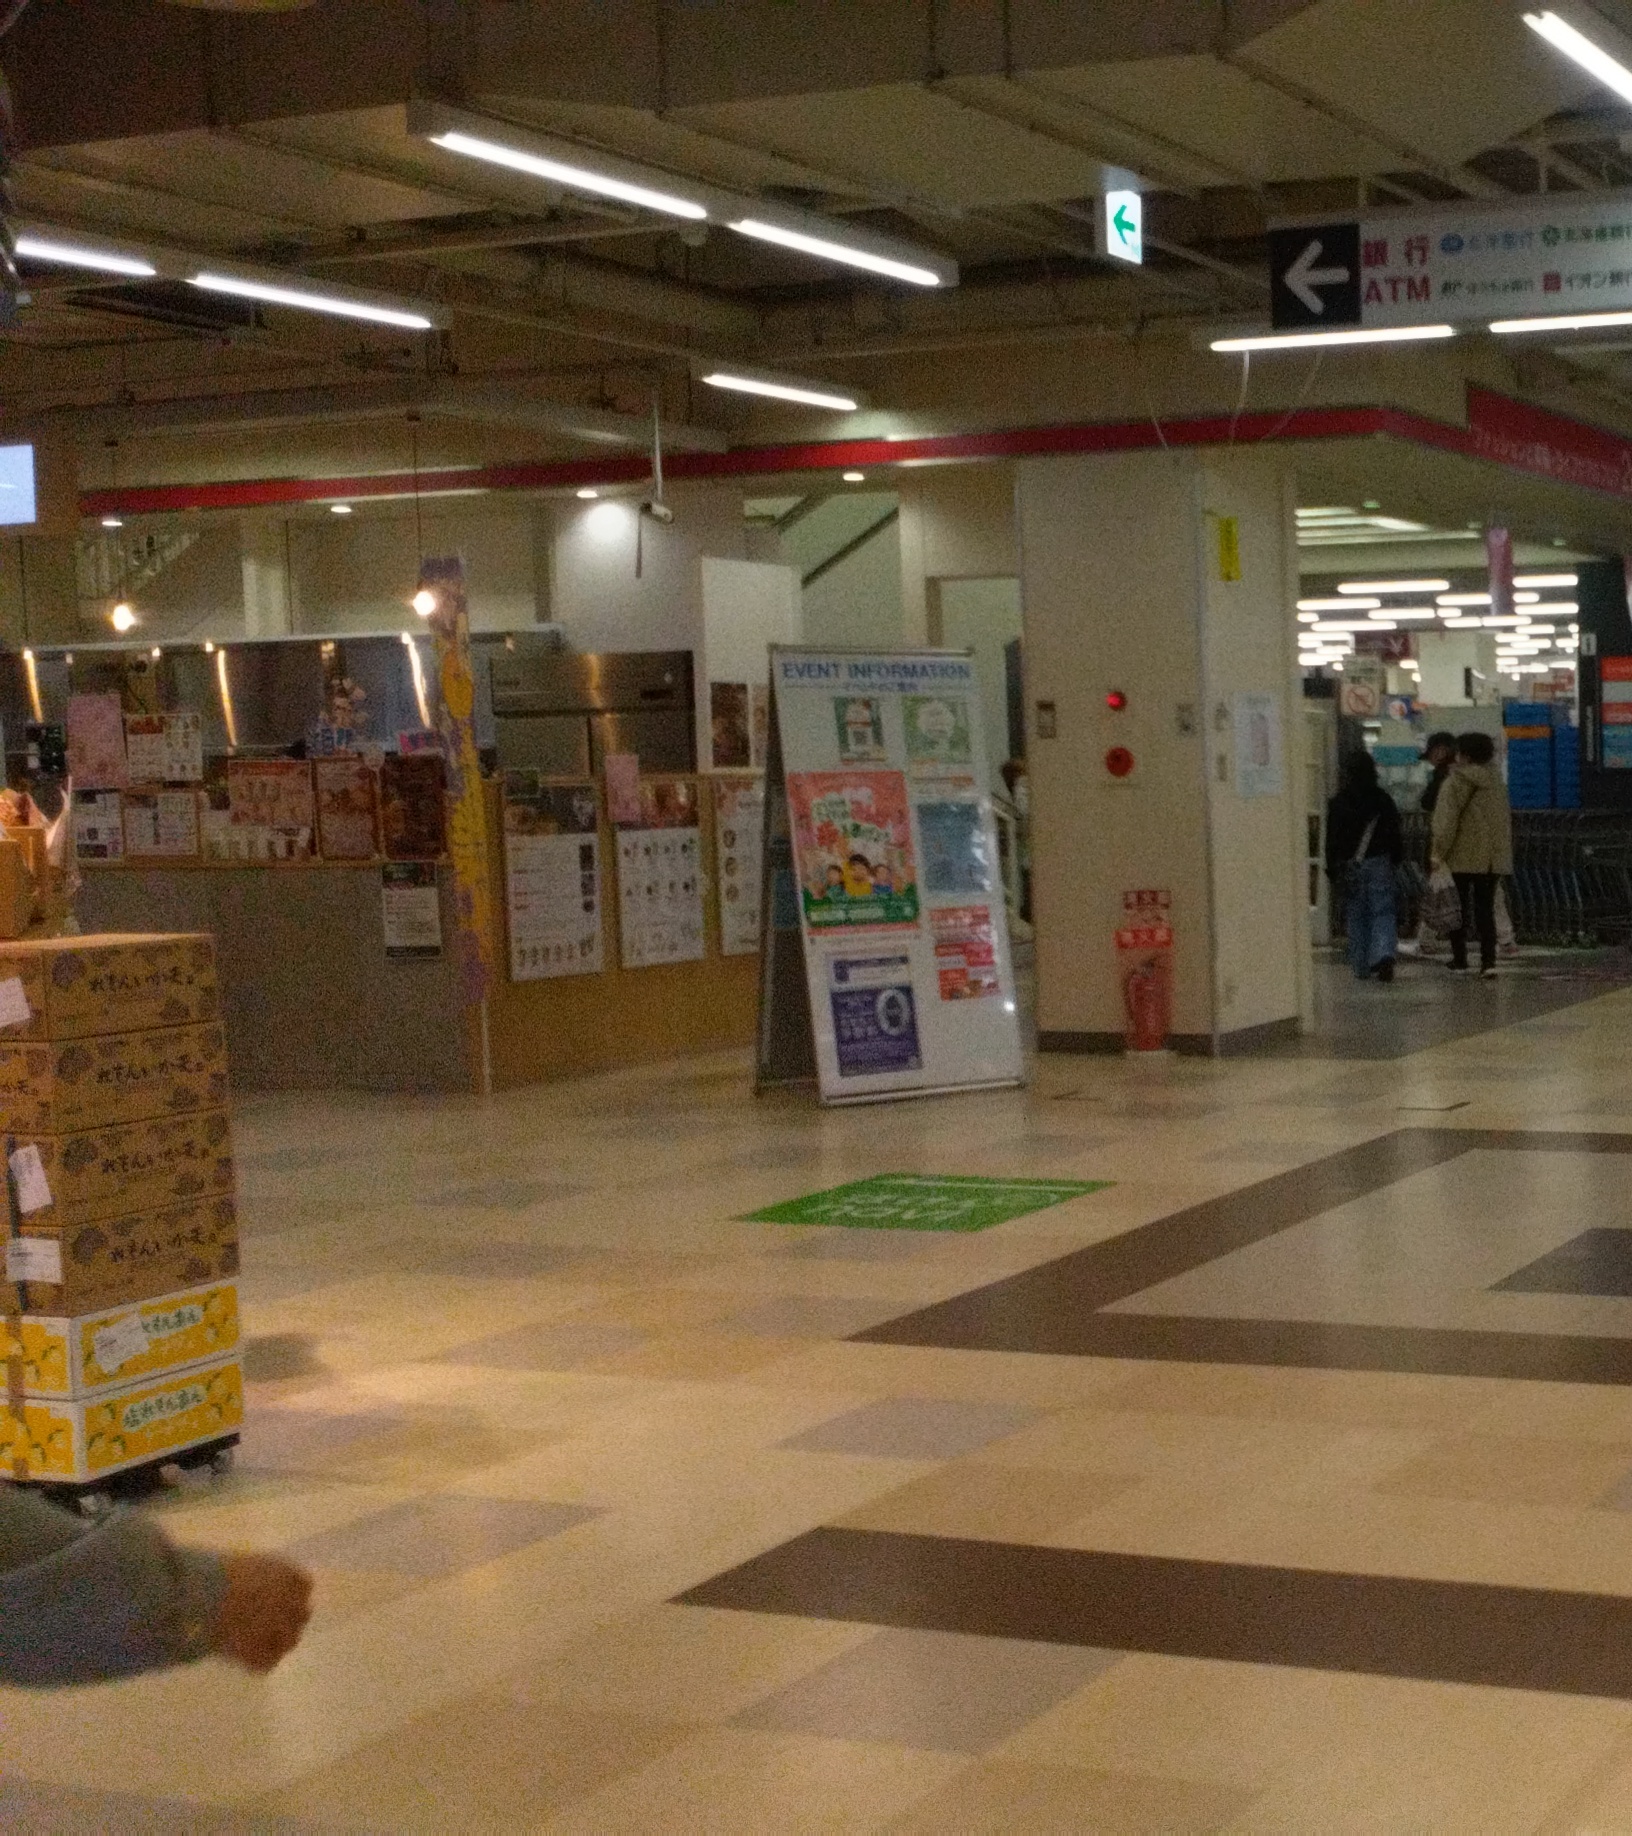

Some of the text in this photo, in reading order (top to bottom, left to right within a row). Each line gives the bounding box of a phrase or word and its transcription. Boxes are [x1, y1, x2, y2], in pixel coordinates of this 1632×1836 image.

[1363, 233, 1431, 267] 銀行
[1363, 274, 1432, 303] ATM
[783, 662, 972, 679] EVENT INFORMATION
